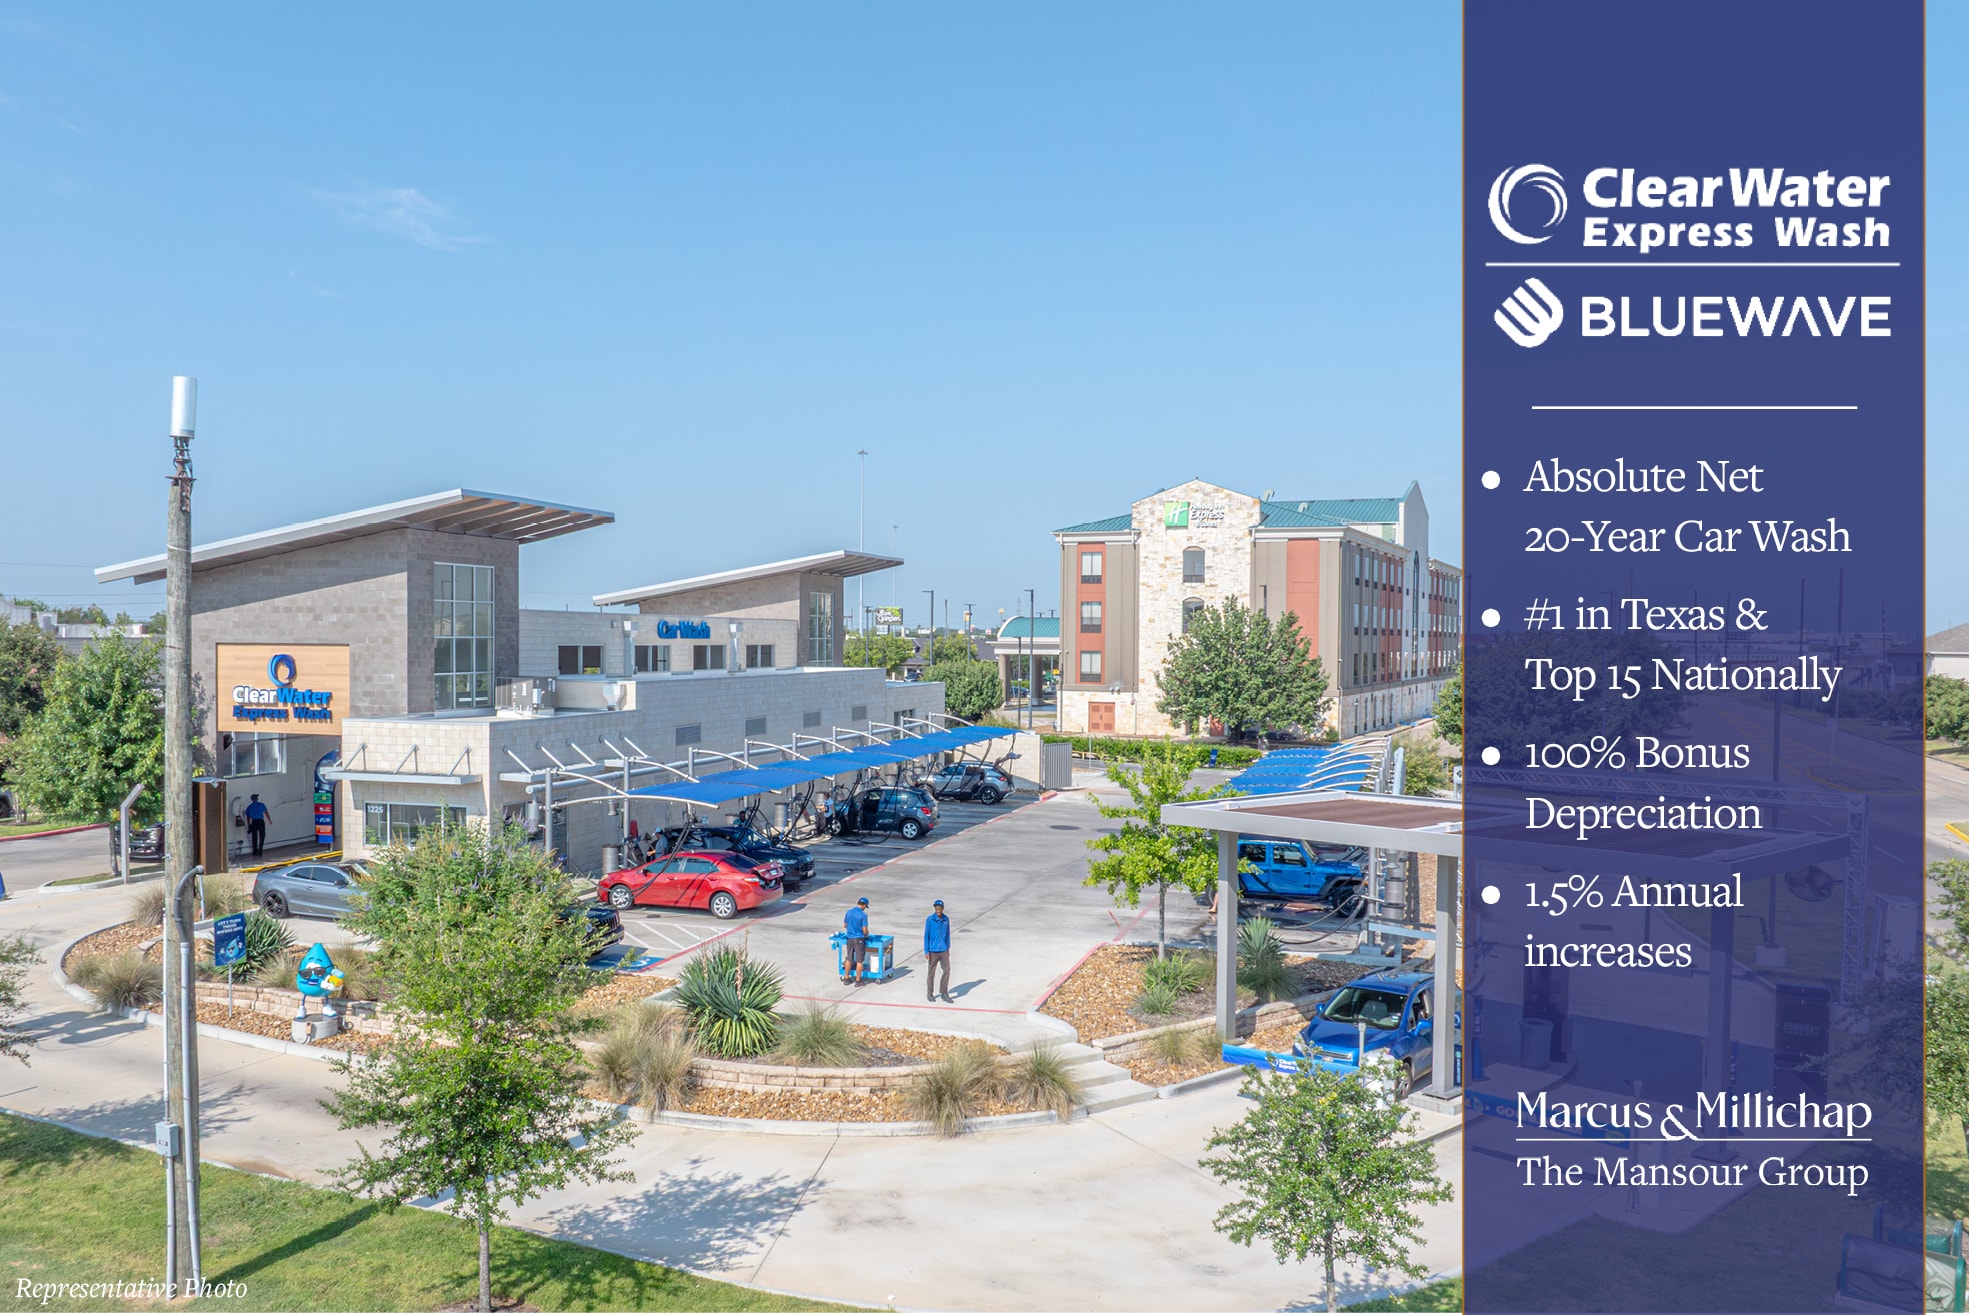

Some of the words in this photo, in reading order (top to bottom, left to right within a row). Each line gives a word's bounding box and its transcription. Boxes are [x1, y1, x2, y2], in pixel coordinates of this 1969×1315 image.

[1190, 509, 1225, 522] Express
[232, 705, 288, 721] Express
[292, 706, 332, 719] Wash
[367, 805, 384, 814] 1225
